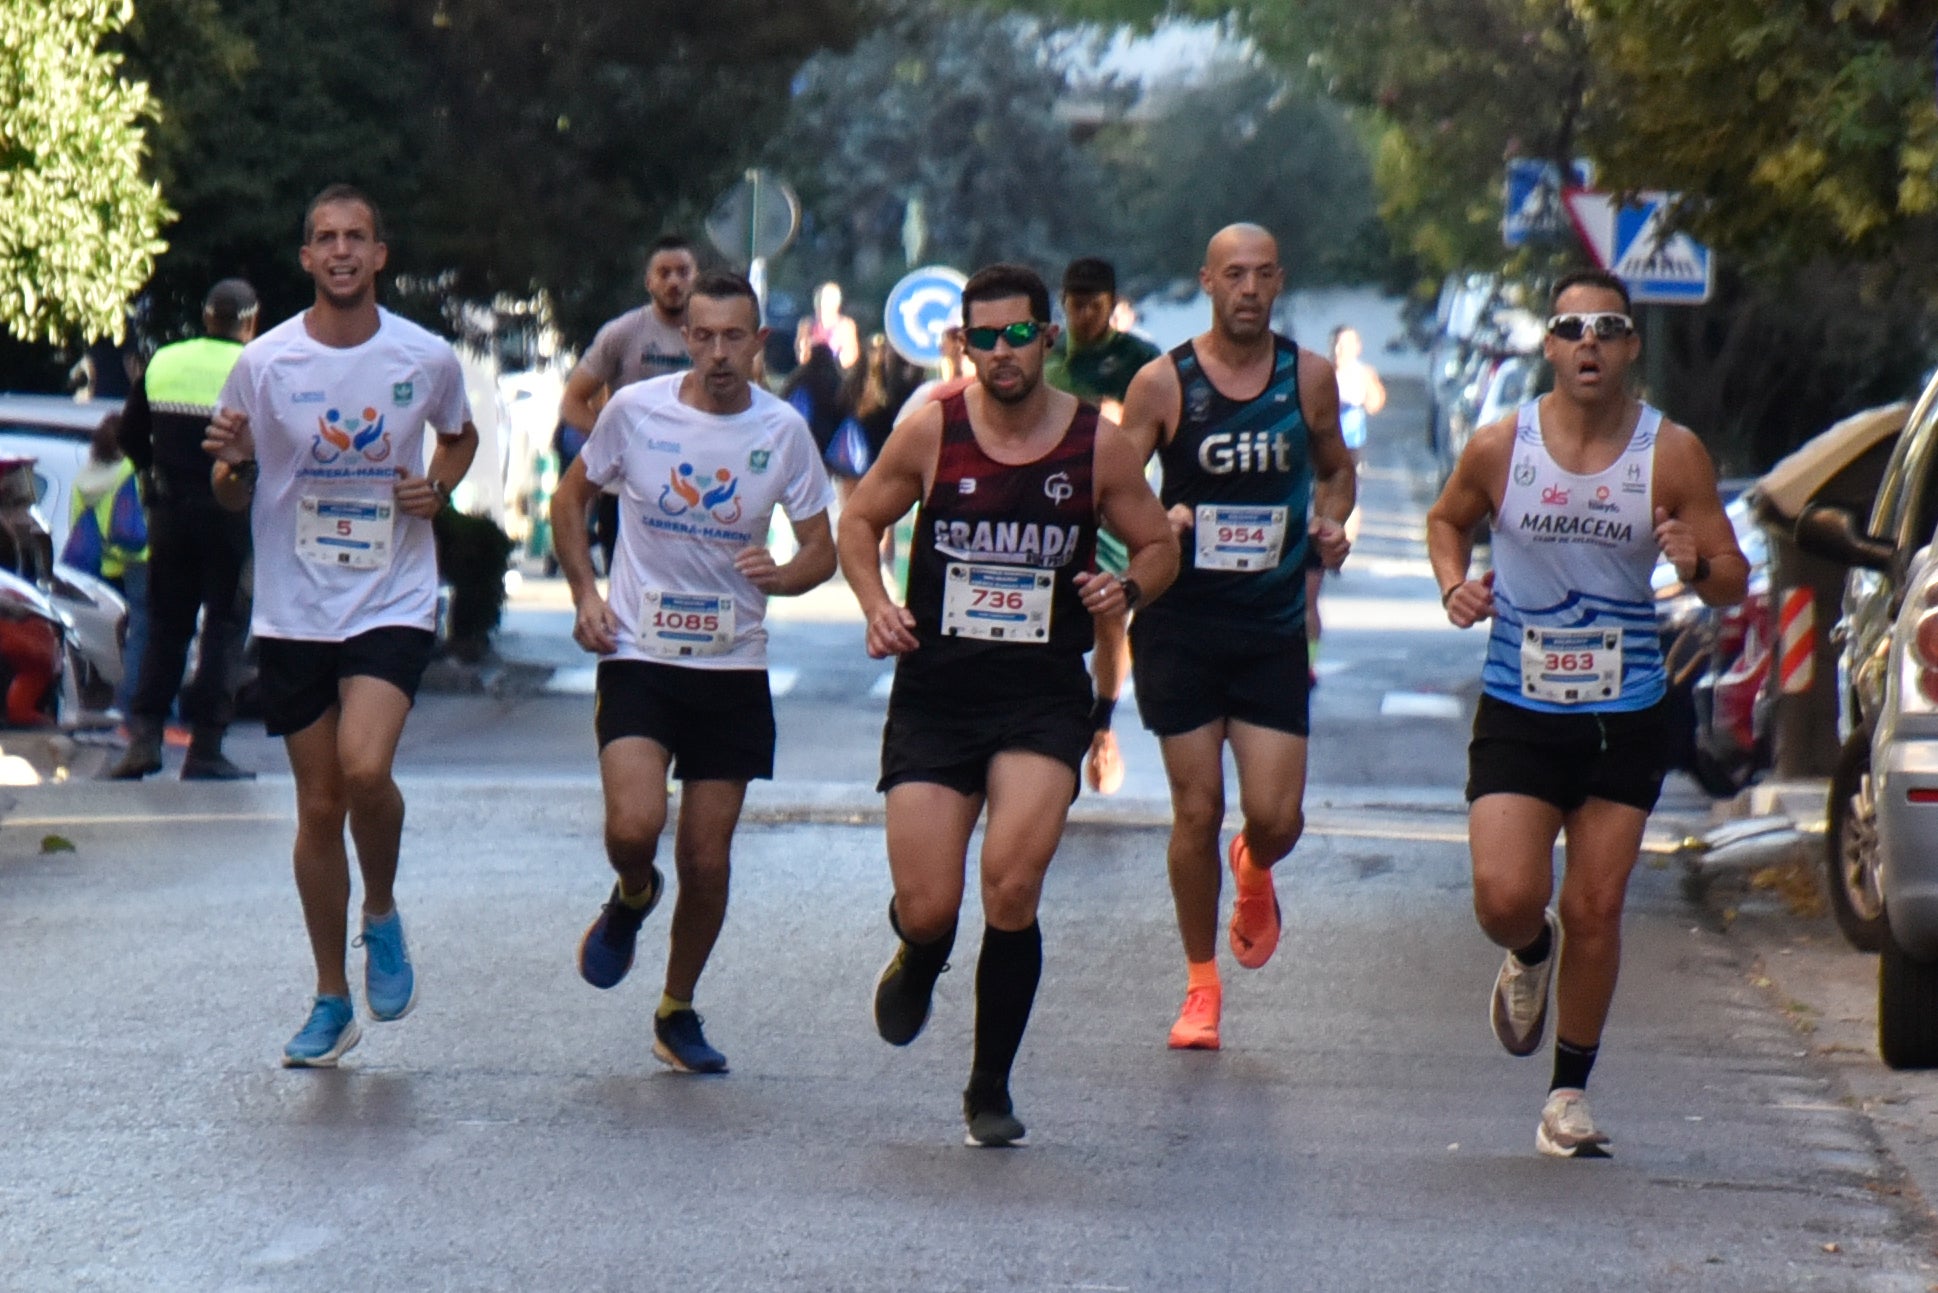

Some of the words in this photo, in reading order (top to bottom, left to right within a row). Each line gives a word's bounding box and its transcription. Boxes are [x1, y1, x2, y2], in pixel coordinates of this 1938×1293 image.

[1198, 431, 1291, 475] Giit
[336, 520, 352, 537] 5
[933, 519, 1081, 556] GRANADA
[1218, 526, 1265, 544] 954
[1520, 513, 1633, 543] MARACENA
[971, 588, 1023, 610] 736
[652, 611, 719, 632] 1085
[1544, 652, 1594, 672] 363
